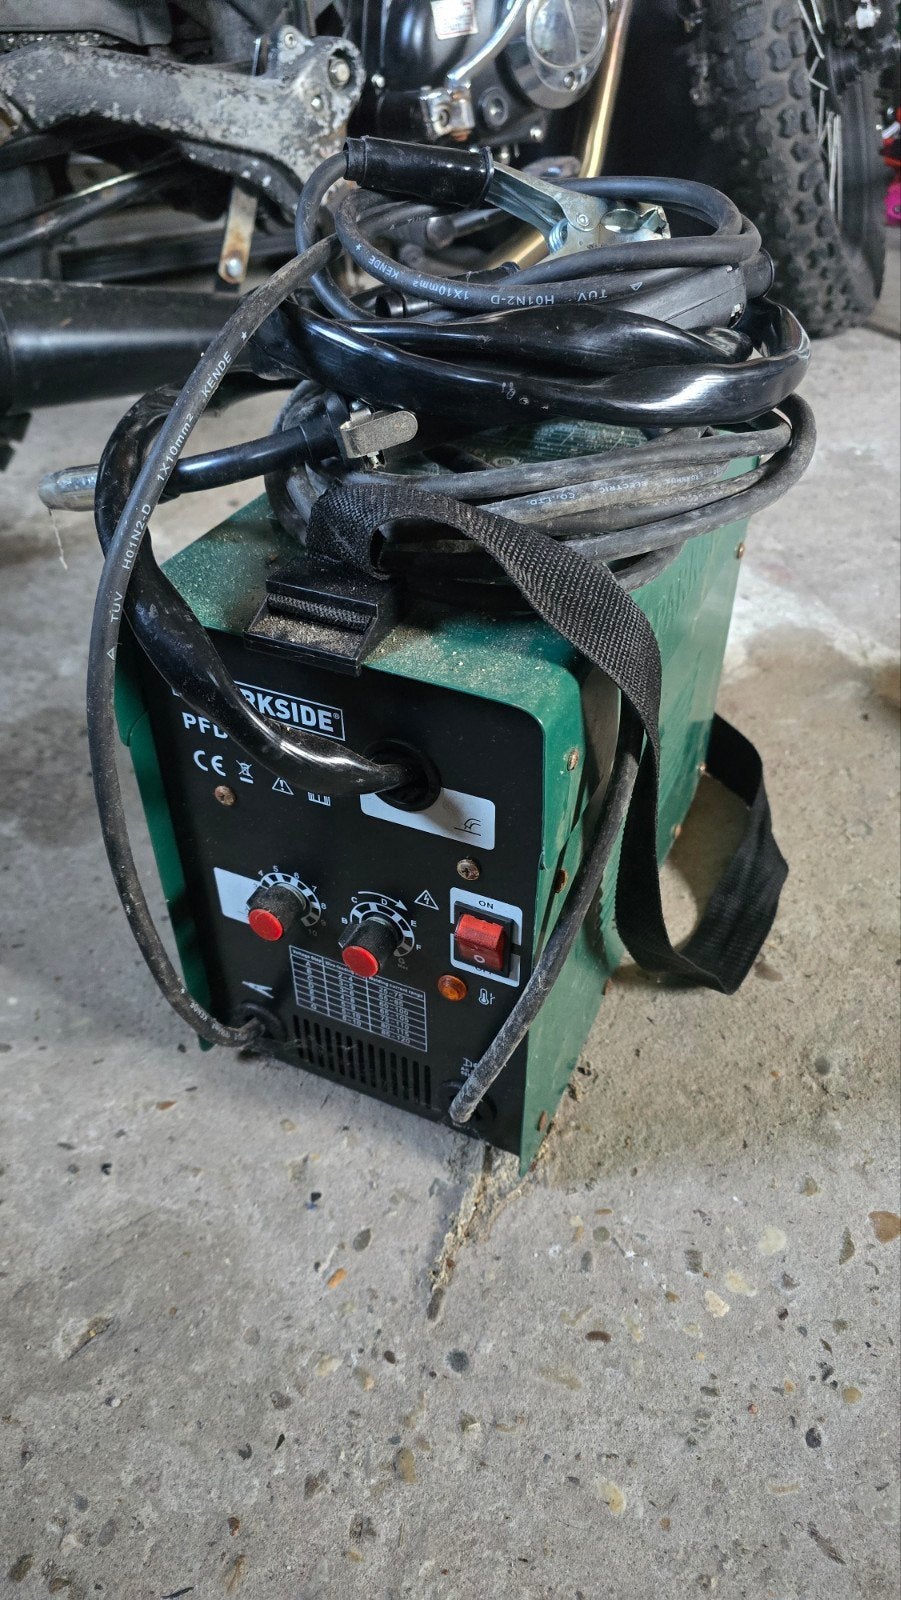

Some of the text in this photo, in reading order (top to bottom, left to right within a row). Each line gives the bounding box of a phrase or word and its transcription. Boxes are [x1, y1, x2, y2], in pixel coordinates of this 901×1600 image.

[368, 255, 400, 279] KENDE
[490, 295, 555, 306] H01N2-D
[110, 591, 123, 623] TUV
[122, 504, 151, 570] H01N2-D
[200, 351, 233, 398] KENDE
[272, 865, 279, 873] 5
[350, 896, 358, 904] C
[381, 898, 388, 906] D
[478, 900, 494, 910] ON
[410, 920, 417, 928] E
